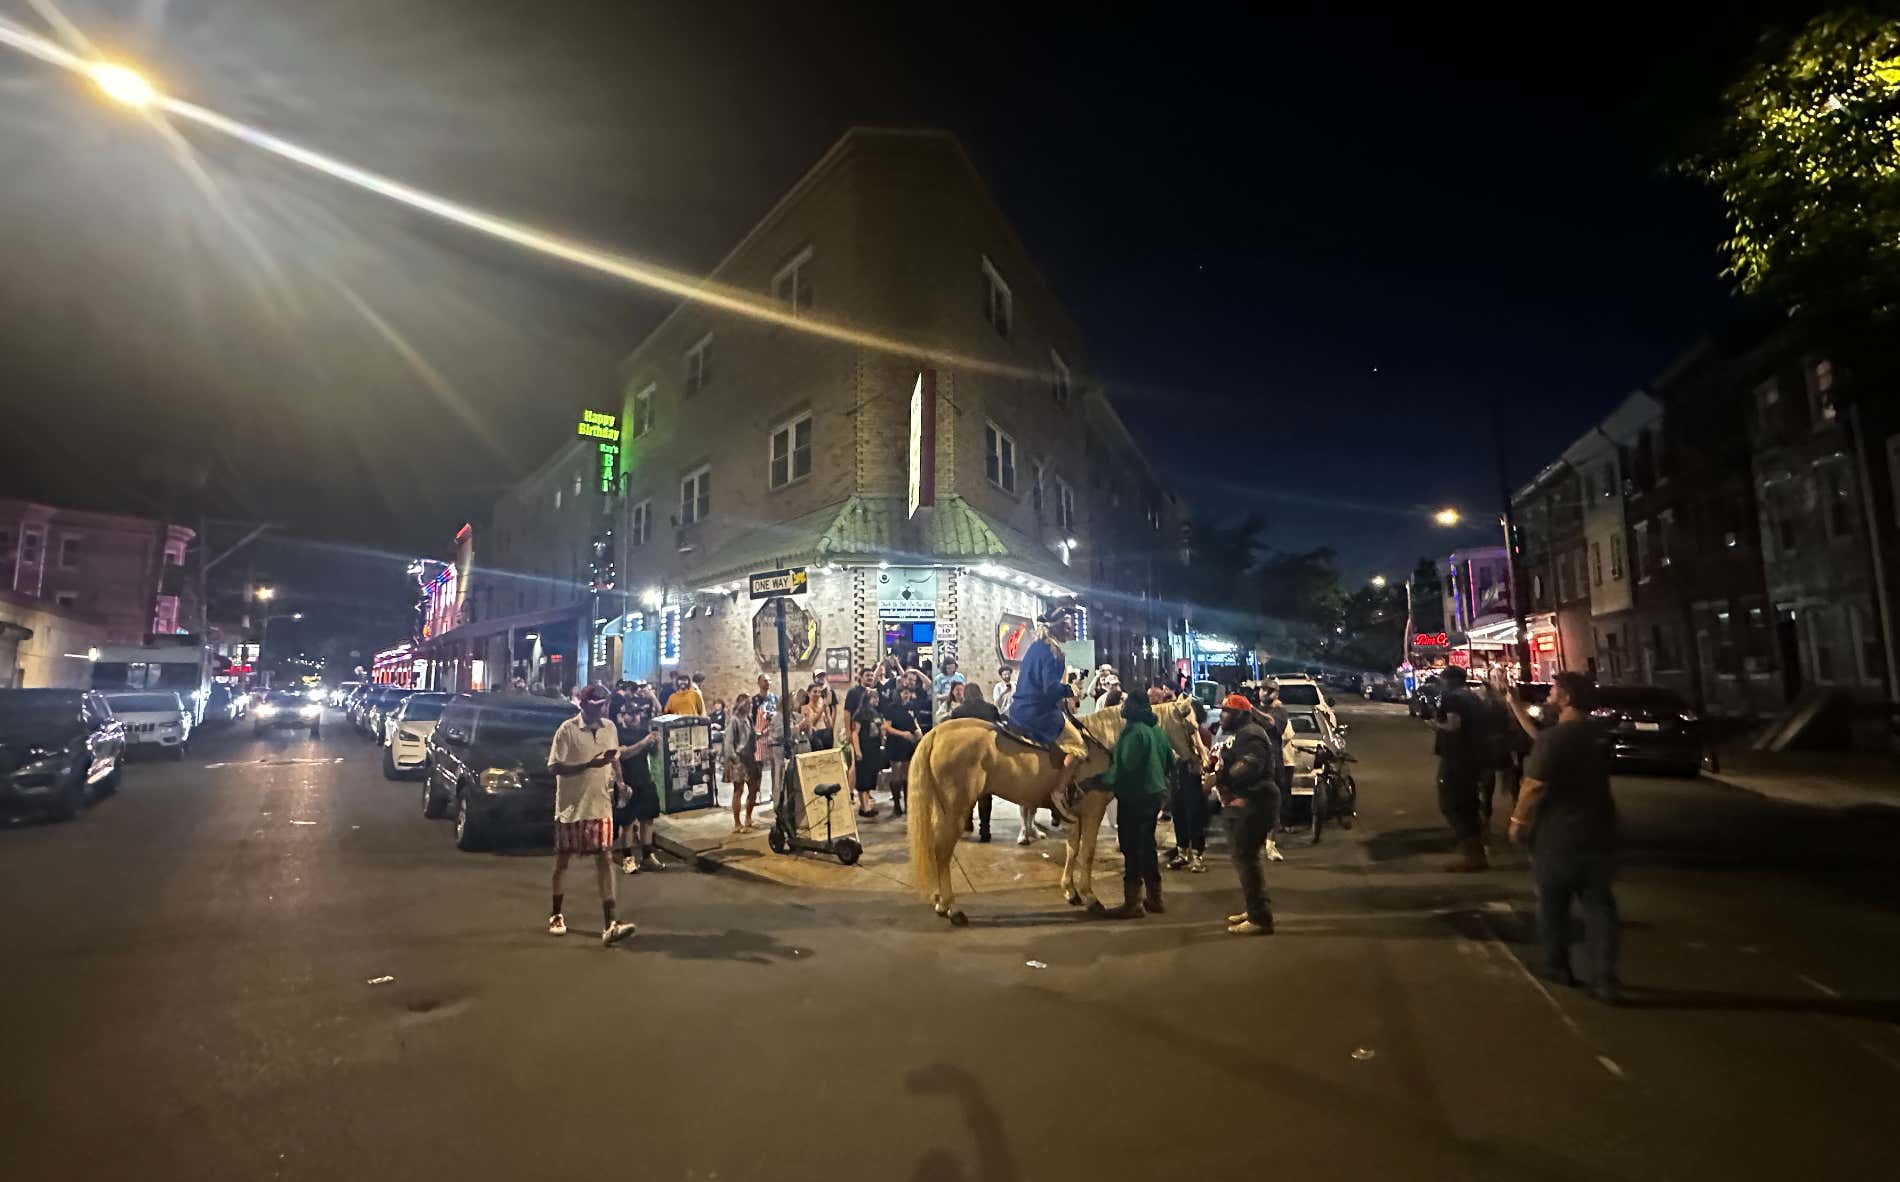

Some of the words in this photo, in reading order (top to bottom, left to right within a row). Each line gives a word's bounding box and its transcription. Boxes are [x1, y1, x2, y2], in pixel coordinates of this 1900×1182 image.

[584, 409, 616, 427] Happy
[577, 422, 620, 441] Birthday
[754, 580, 770, 591] ONE
[772, 577, 789, 588] WAY
